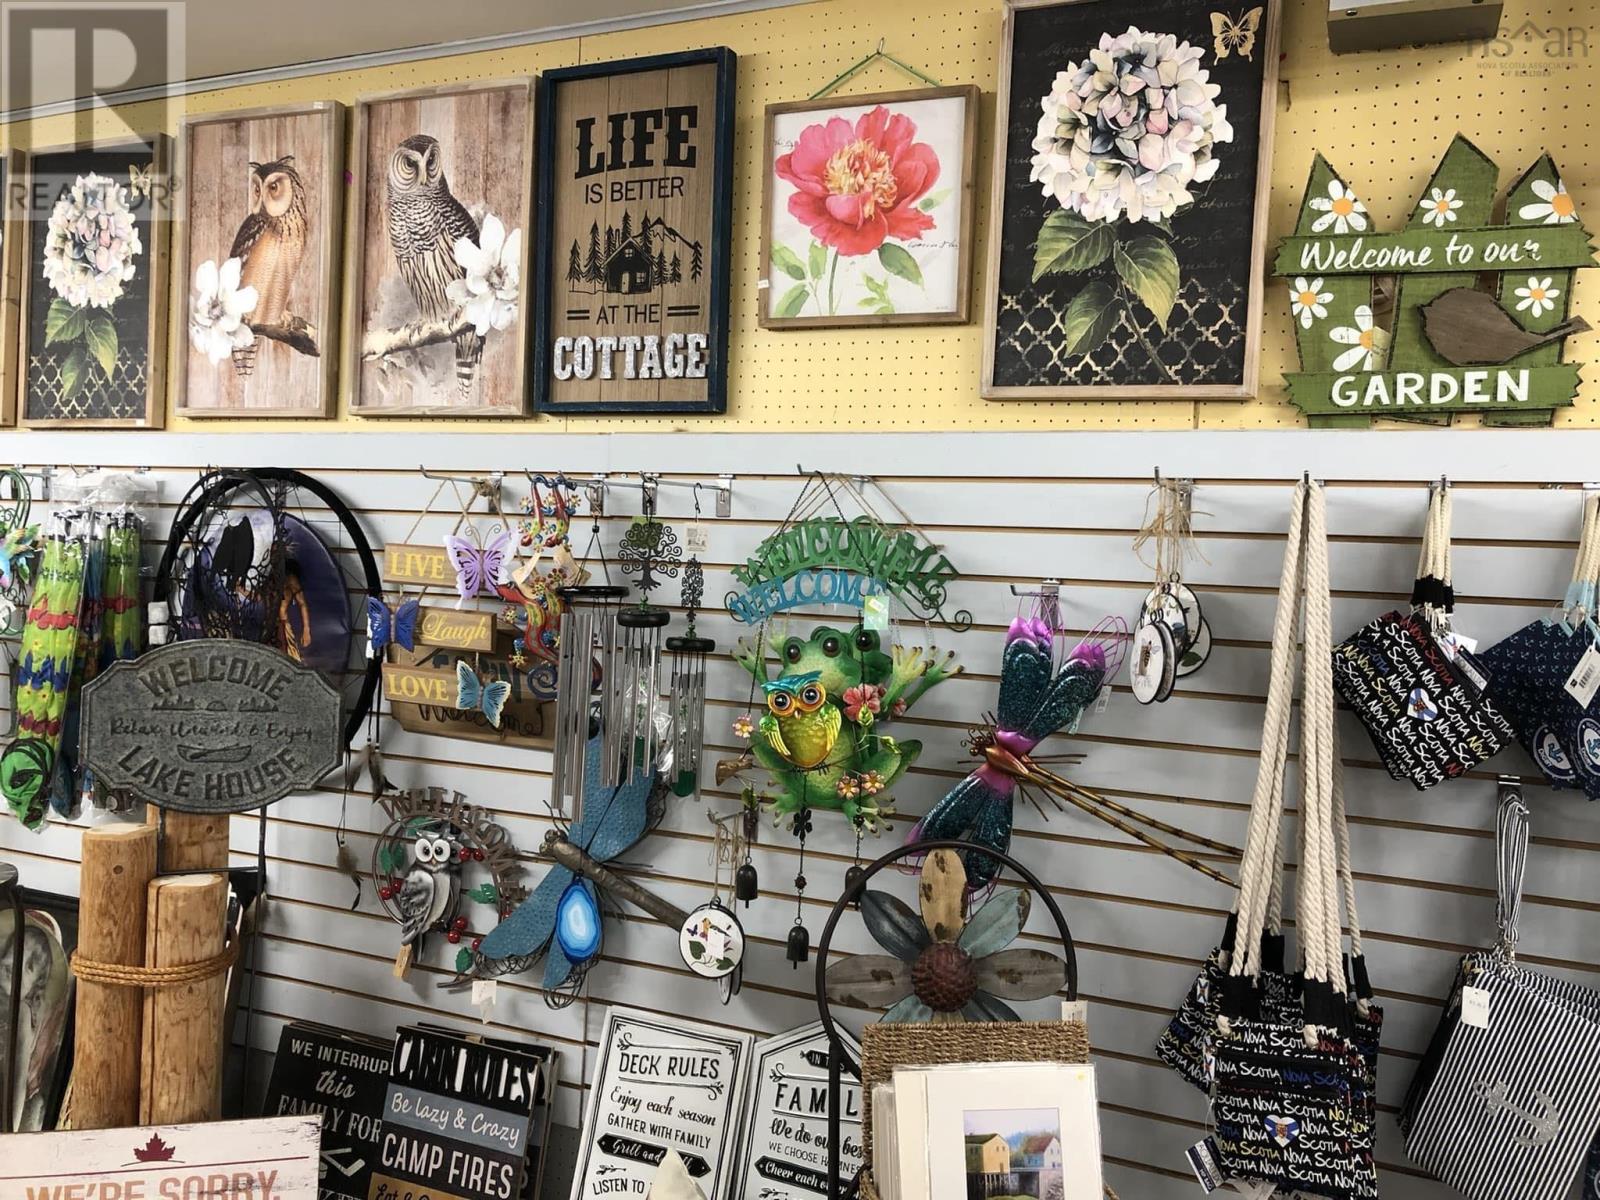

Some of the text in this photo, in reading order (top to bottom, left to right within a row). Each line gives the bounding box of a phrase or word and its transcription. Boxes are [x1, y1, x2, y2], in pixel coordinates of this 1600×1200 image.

[575, 105, 698, 179] LIFE
[585, 176, 684, 204] IS BETTER
[1300, 236, 1435, 270] Welcome
[1445, 233, 1474, 265] to
[596, 303, 660, 325] AT THE
[553, 333, 710, 380] COTTAGE
[1331, 370, 1530, 407] GARDEN
[389, 551, 445, 579] LIVE
[421, 613, 489, 647] Laugh
[138, 655, 293, 700] WELCOME
[1387, 646, 1416, 687] SCOTIA
[387, 673, 449, 701] LOVE
[1386, 674, 1407, 702] NOVA
[1395, 630, 1423, 670] SCOTIA
[1420, 669, 1441, 697] NOVA
[1439, 696, 1470, 737] SCOTIA
[1343, 661, 1370, 700] SCOTIA
[1367, 699, 1389, 727] NOVA
[1386, 727, 1414, 768] SCOTIA
[1371, 677, 1400, 717] SCOTIA
[1397, 717, 1417, 745] NOVA
[1413, 743, 1444, 782] SCOTIA
[1450, 685, 1472, 713] NOVA
[1469, 711, 1500, 753] SCOTIA
[1480, 698, 1513, 737] SCOTIA
[266, 722, 313, 746] Enjoy
[1418, 722, 1449, 765] SCOTIA
[1433, 718, 1457, 746] NOVA
[118, 746, 304, 800] LAKE HOUSE
[1244, 1028, 1267, 1045] NOVA
[291, 1038, 390, 1075] WE INTERRUP
[619, 1052, 720, 1080] DECK RULES
[811, 1054, 820, 1065] IN
[1216, 1059, 1238, 1075] NOVA
[1240, 1062, 1281, 1080] SCOTIA
[315, 1068, 356, 1098] this
[391, 1092, 520, 1149] Be lazy & Crazy
[610, 1086, 717, 1127] Enjoy each season
[1218, 1095, 1251, 1109] SCOTIA
[1253, 1094, 1281, 1113] NOVA
[1283, 1100, 1326, 1120] SCOTIA
[1222, 1106, 1260, 1125] SCOTIA
[1301, 1118, 1330, 1136] NOVA
[346, 1112, 383, 1143] FOR
[607, 1113, 711, 1149] GATHER WITH FAMILY
[769, 1117, 862, 1159] We do ou bes
[1243, 1125, 1269, 1143] NOVA
[1298, 1134, 1342, 1155] SCOTIA
[381, 1132, 513, 1200] CAMP FIRES
[612, 1139, 664, 1163] Grill and
[769, 1141, 782, 1153] WE
[784, 1145, 818, 1164] CHOOSE
[1240, 1142, 1281, 1160] SCOTIA
[1284, 1147, 1312, 1166] NOVA
[765, 1161, 794, 1178] Cheer
[795, 1172, 819, 1187] each
[1221, 1151, 1258, 1172] SCOTIA
[1260, 1159, 1286, 1177] NOVA
[1288, 1165, 1332, 1186] SCOTIA
[593, 1178, 645, 1195] LISTEN TO
